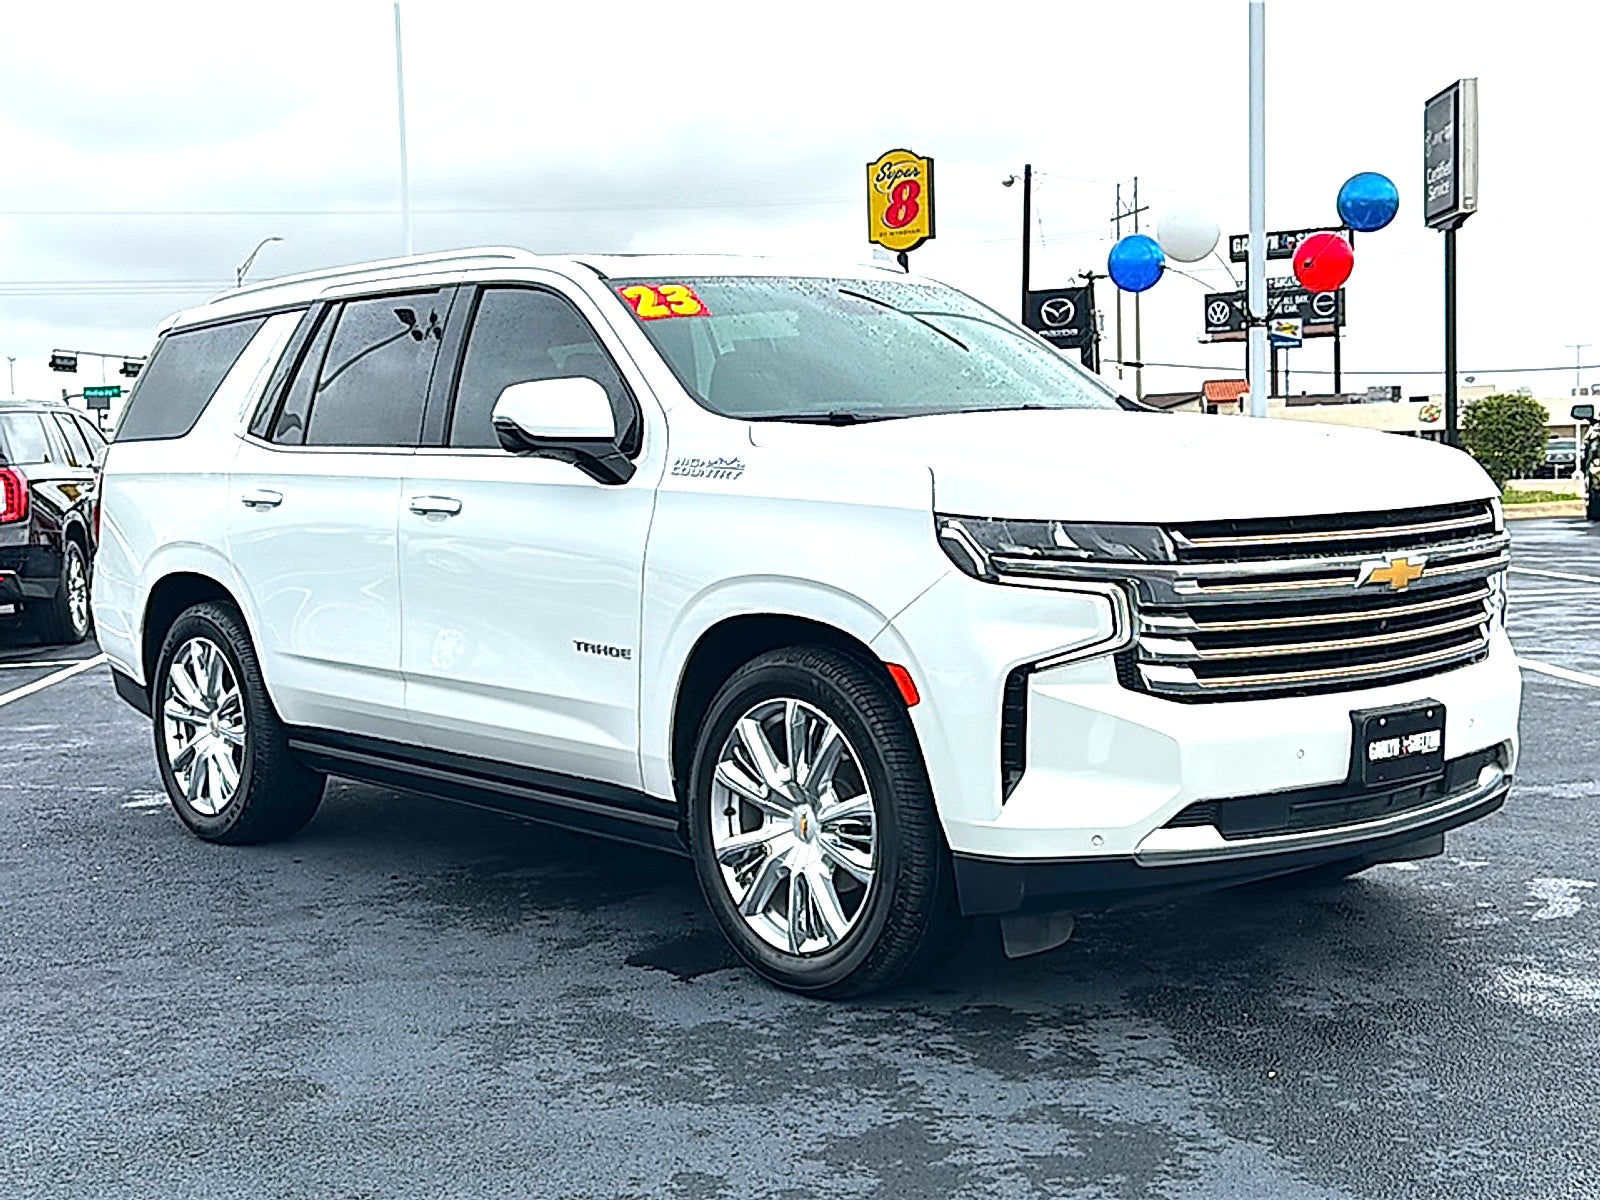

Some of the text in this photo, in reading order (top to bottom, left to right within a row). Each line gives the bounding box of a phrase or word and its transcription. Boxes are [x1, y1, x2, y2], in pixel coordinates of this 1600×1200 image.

[876, 161, 921, 190] Super
[885, 179, 921, 229] 8
[621, 285, 701, 317] 23
[670, 467, 743, 481] COUNTRY
[573, 640, 632, 660] TAHOE
